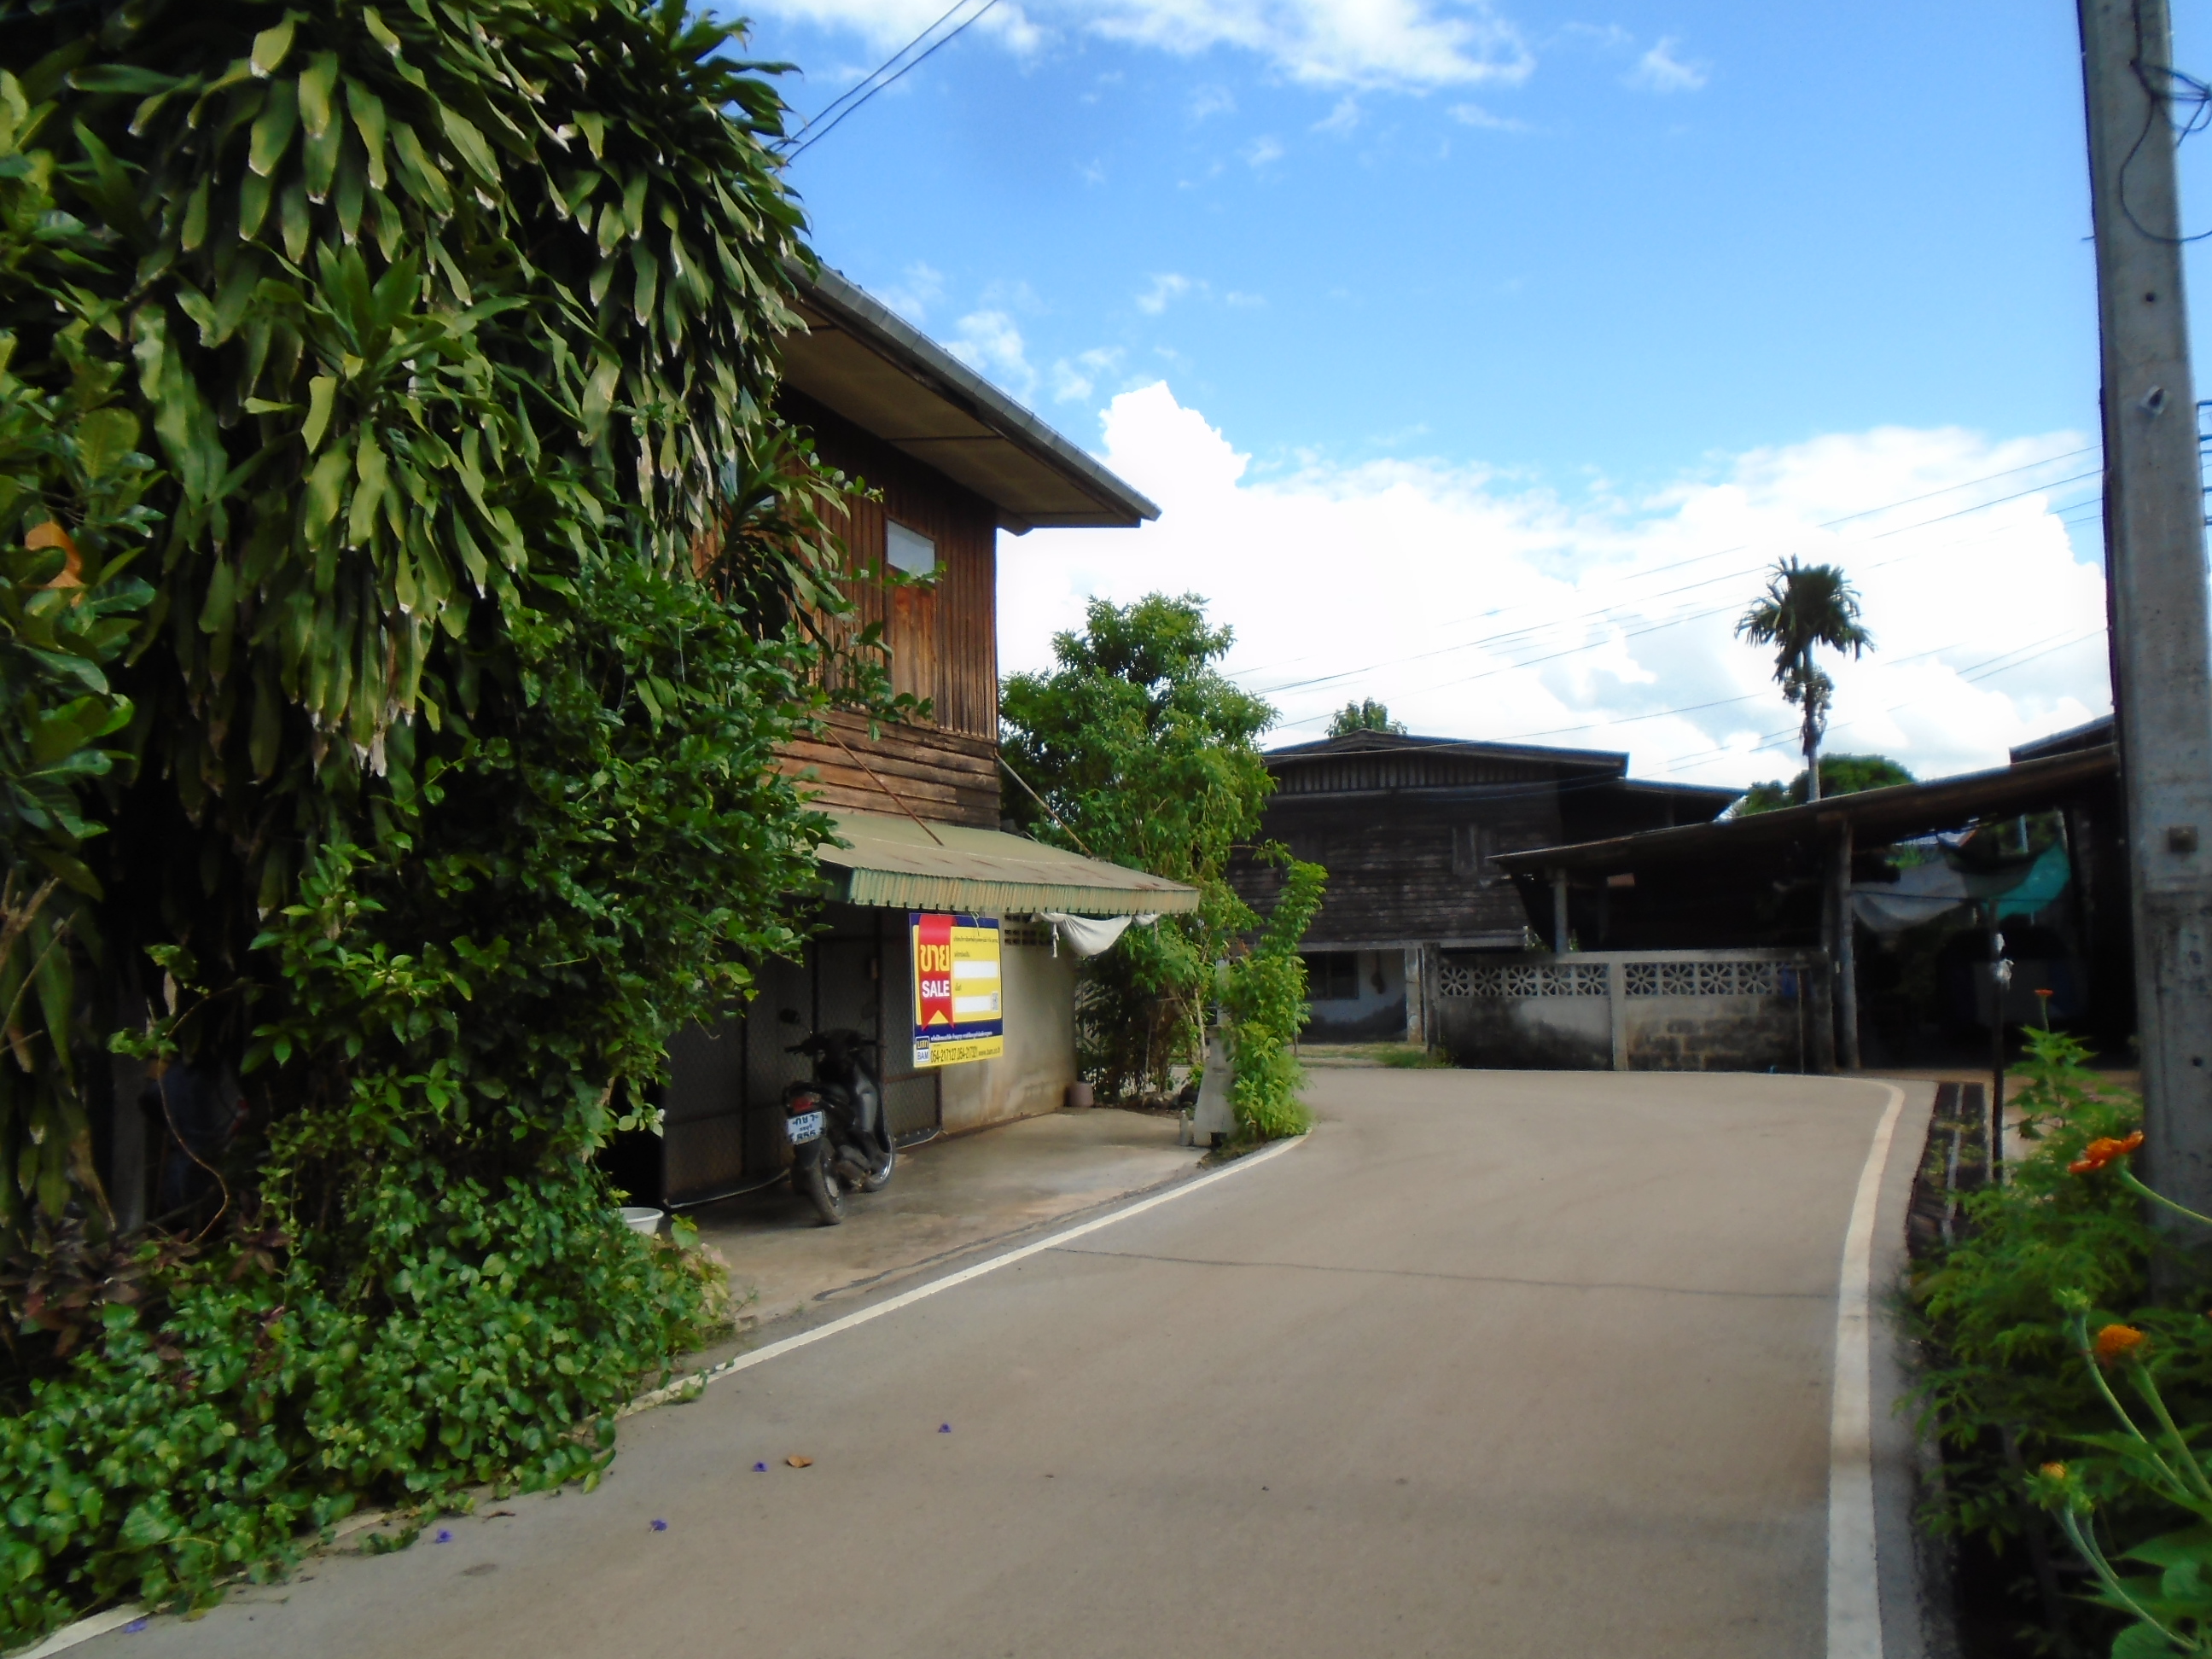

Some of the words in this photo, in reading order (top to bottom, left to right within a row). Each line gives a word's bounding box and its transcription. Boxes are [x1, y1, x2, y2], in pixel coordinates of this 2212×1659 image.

[920, 945, 950, 972] ขาย
[922, 980, 950, 998] SALE
[917, 1051, 929, 1061] BAM
